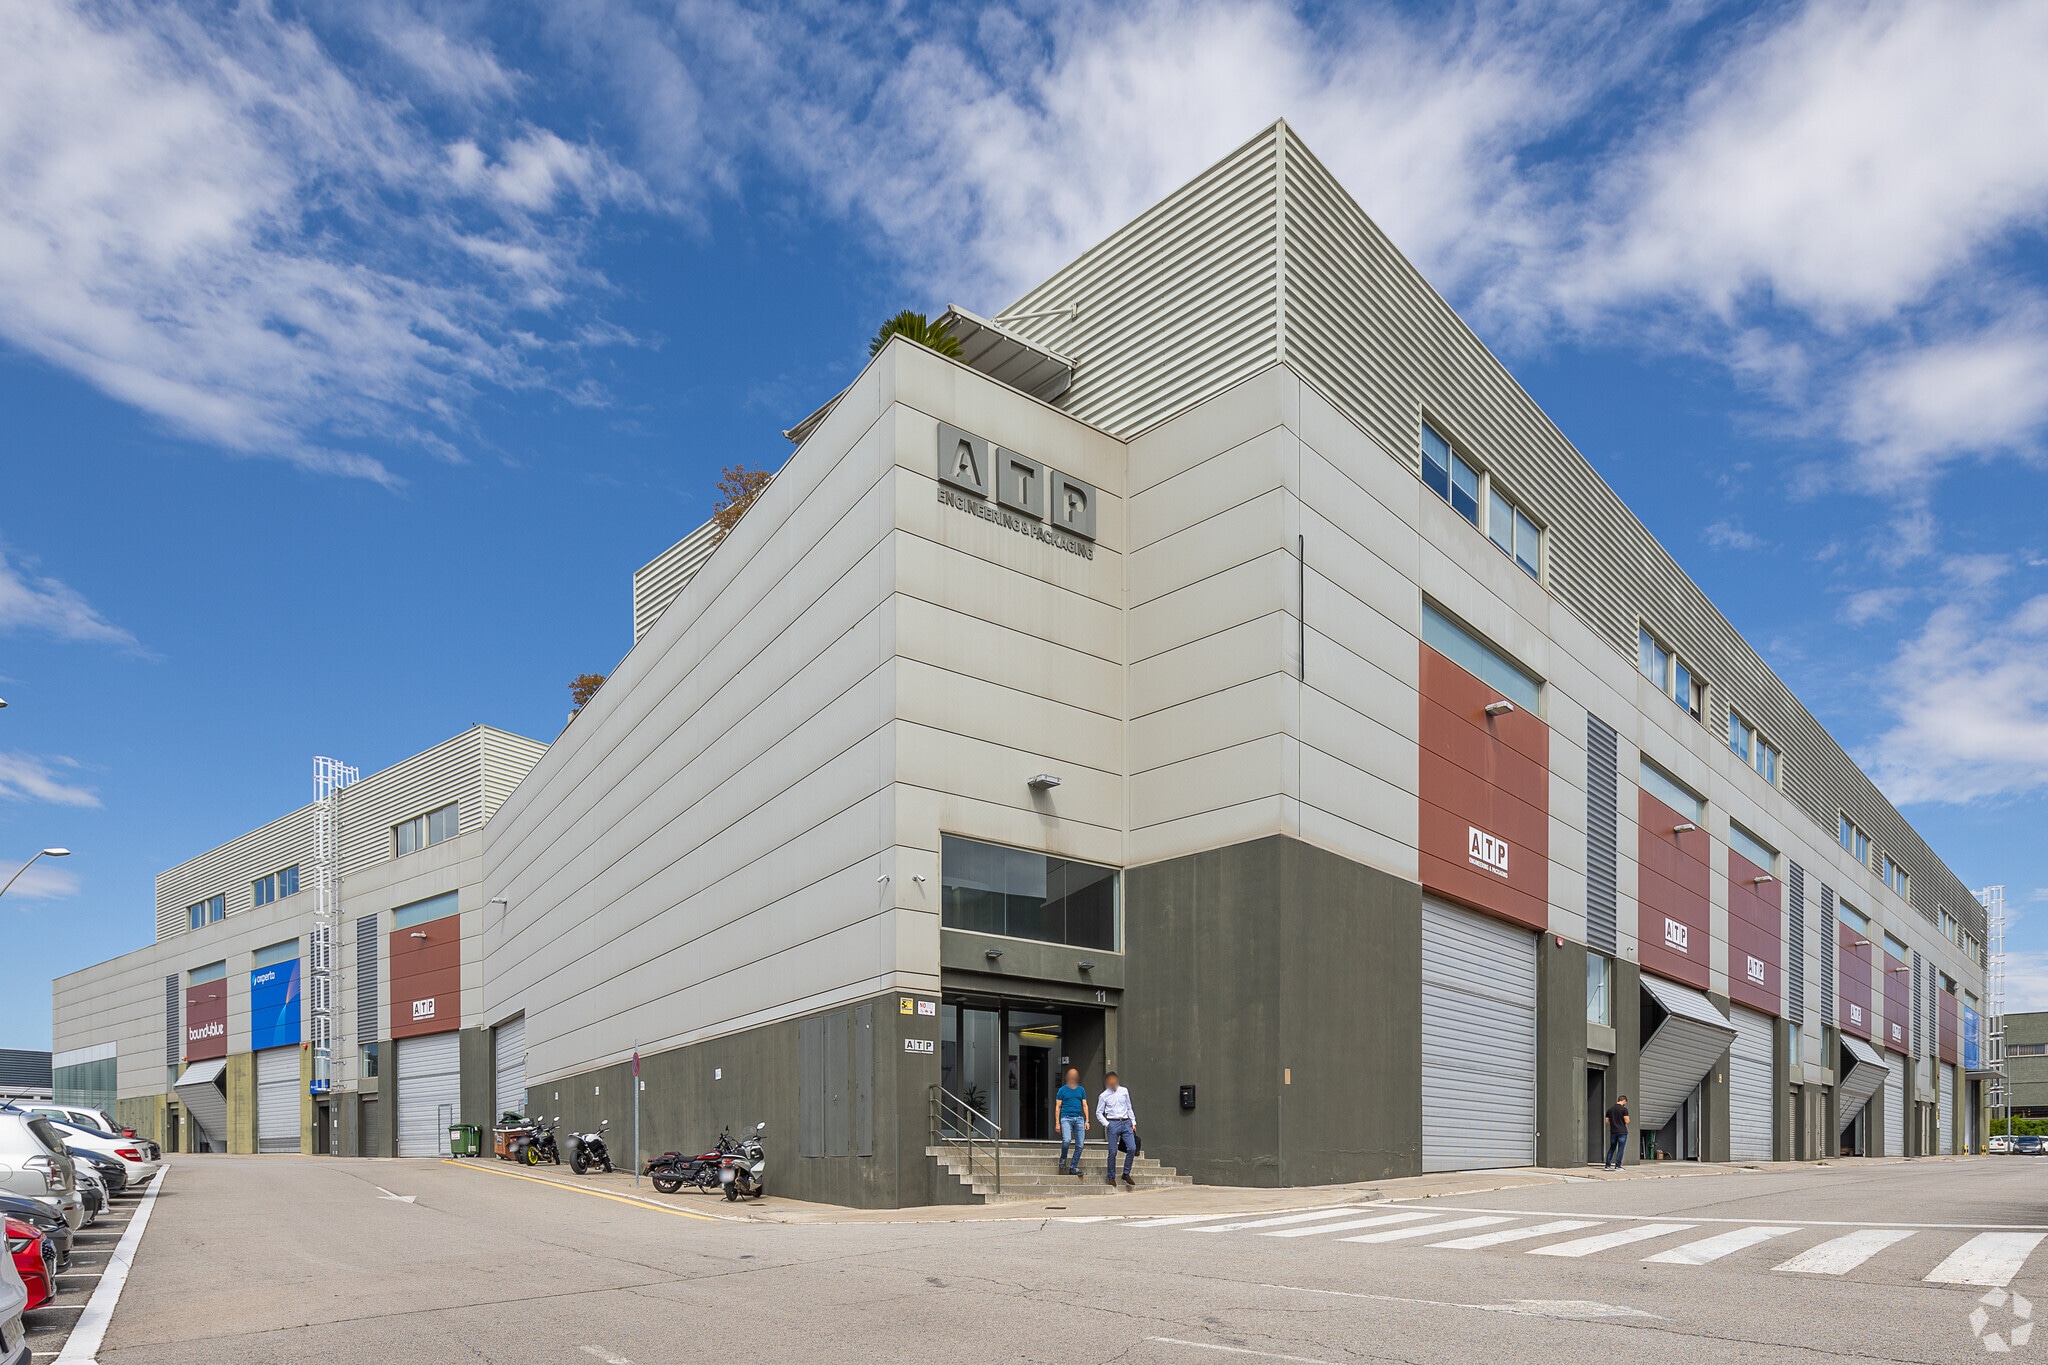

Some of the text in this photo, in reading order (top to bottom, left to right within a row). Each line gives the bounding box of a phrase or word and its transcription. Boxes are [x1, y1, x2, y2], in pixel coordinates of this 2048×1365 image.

[947, 436, 1089, 525] ATP
[937, 487, 1094, 560] ENGINEERING & PACKAGING
[1471, 832, 1506, 865] ATP
[1666, 921, 1686, 944] ATP
[1748, 958, 1763, 978] ATP
[1096, 990, 1106, 1003] 11
[414, 1000, 433, 1015] ATP
[189, 1021, 224, 1041] bound4blue
[906, 1040, 932, 1050] ATP
